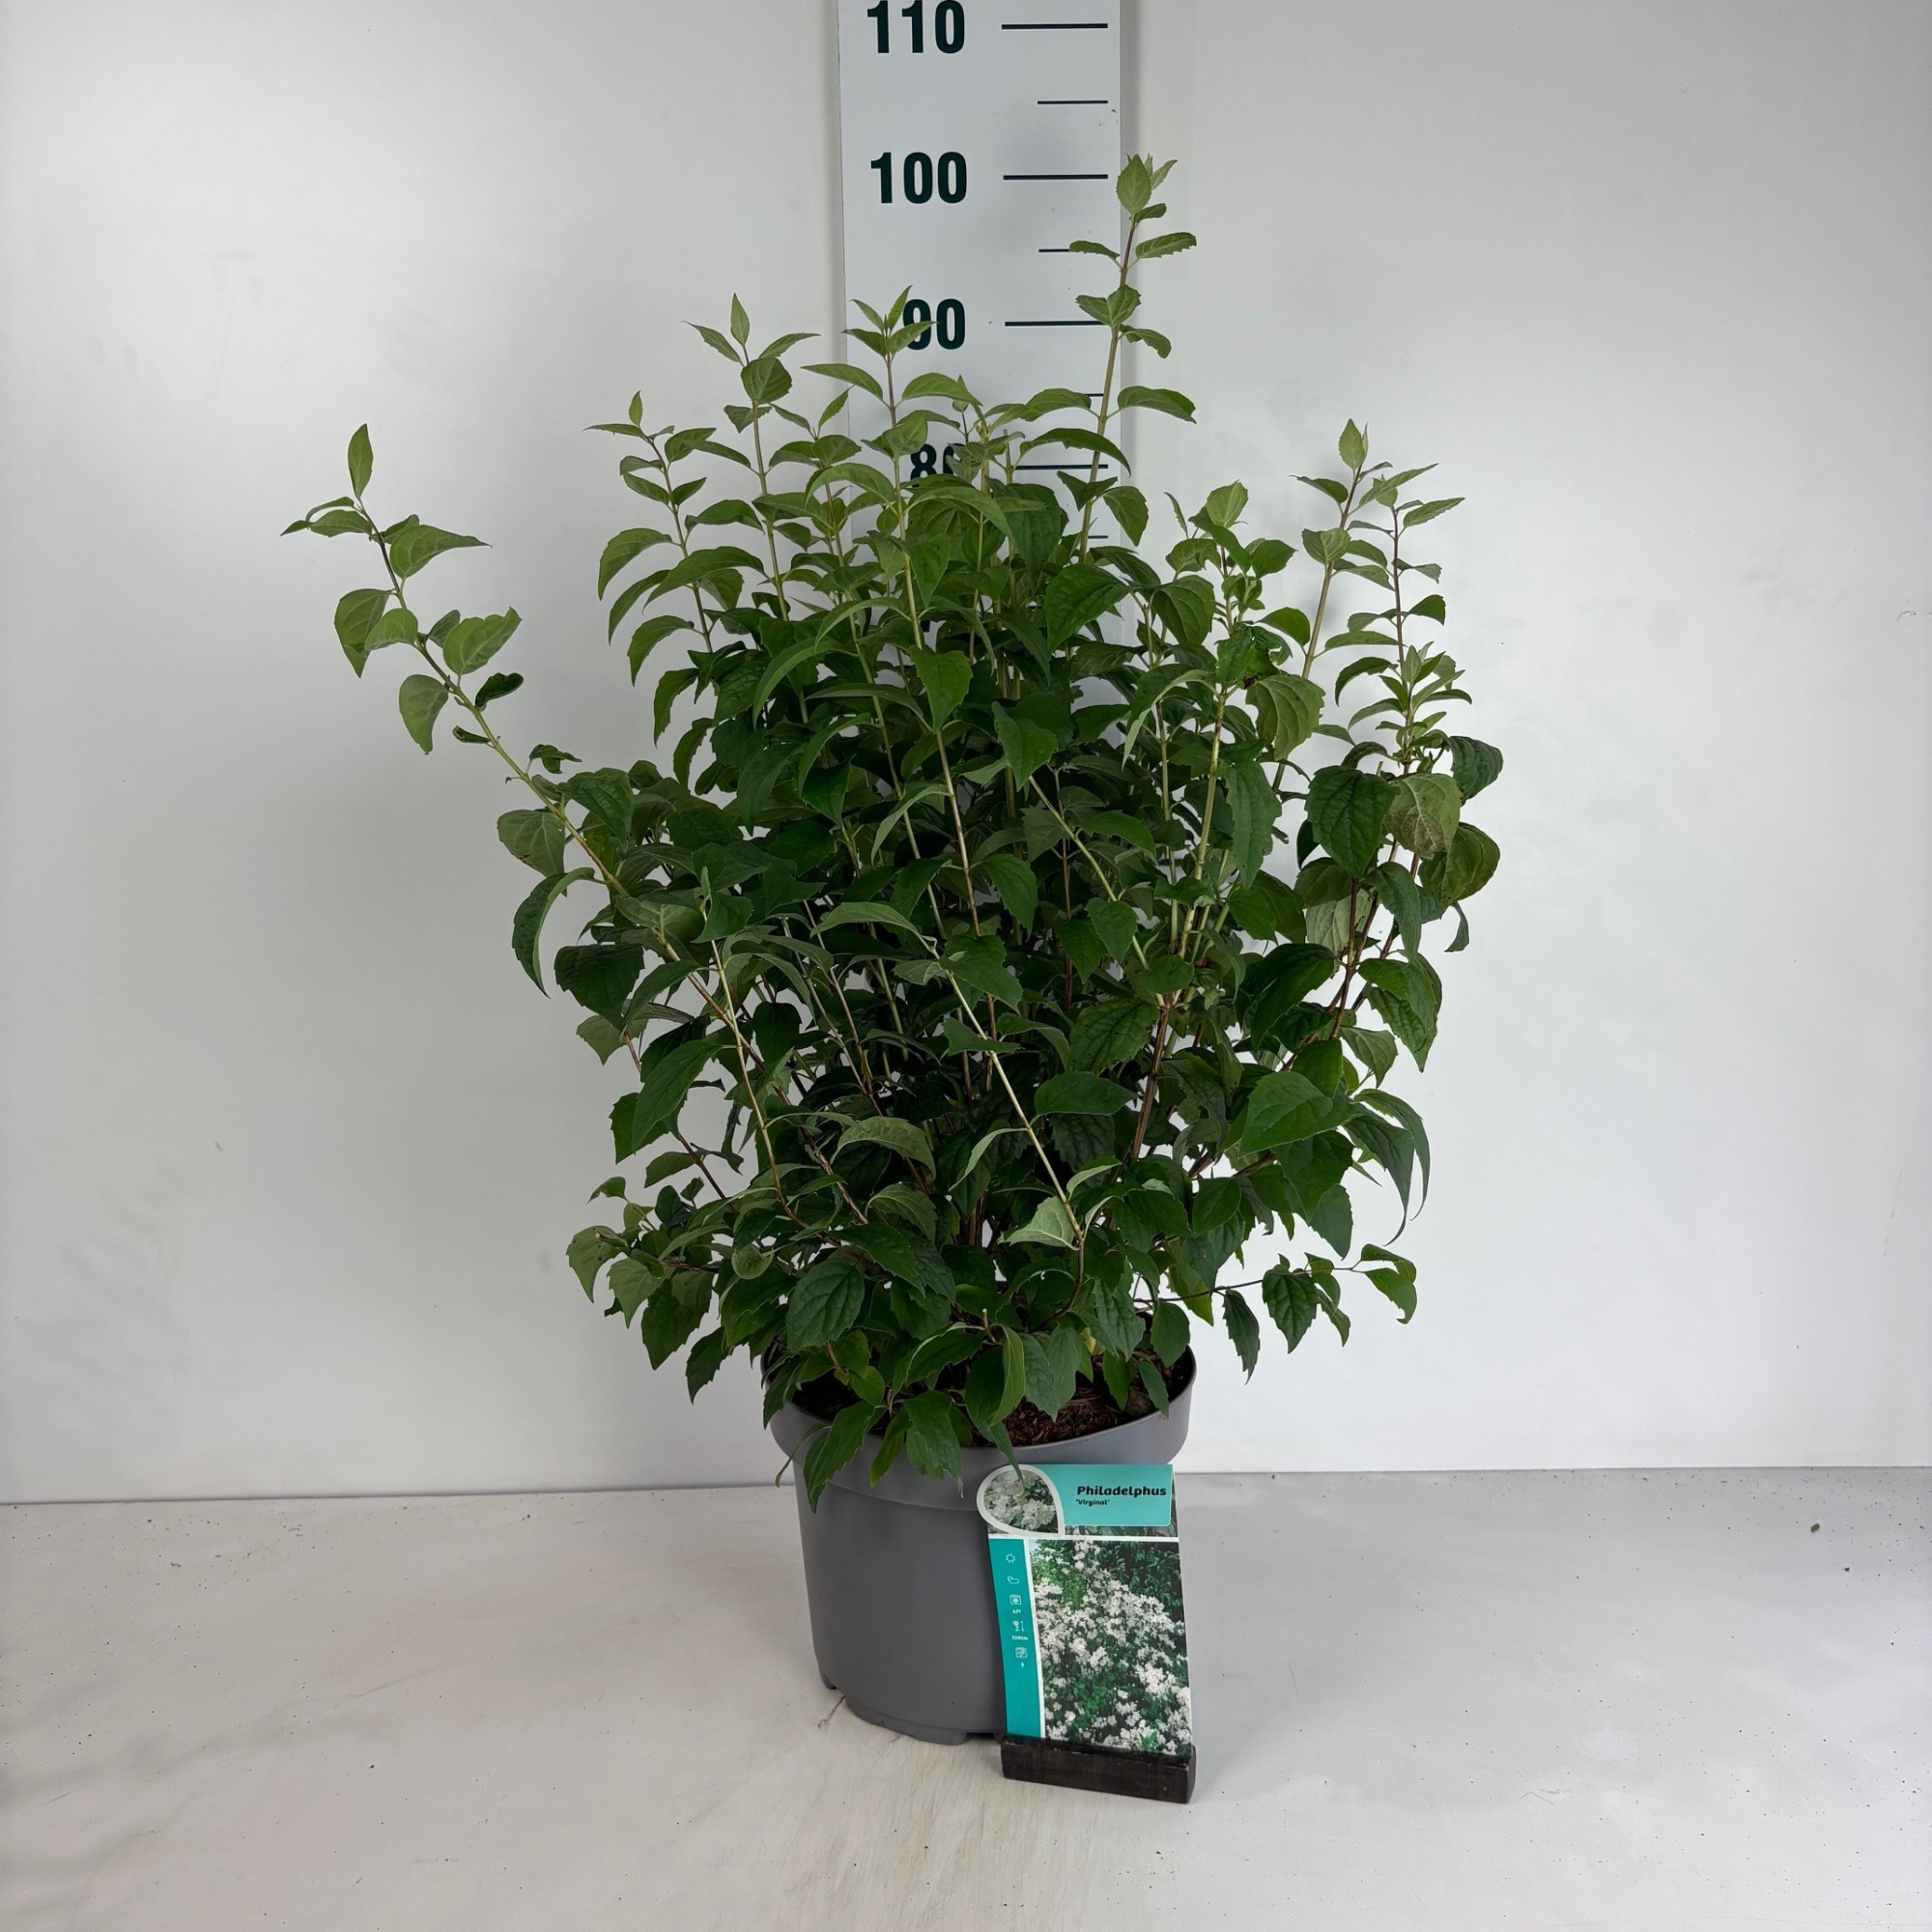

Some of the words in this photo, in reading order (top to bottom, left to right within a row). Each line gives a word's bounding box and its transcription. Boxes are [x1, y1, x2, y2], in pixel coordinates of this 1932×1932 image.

[867, 0, 965, 54] 110
[870, 152, 967, 204] 100
[902, 298, 965, 350] 90
[1077, 1486, 1167, 1497] Philadelphus
